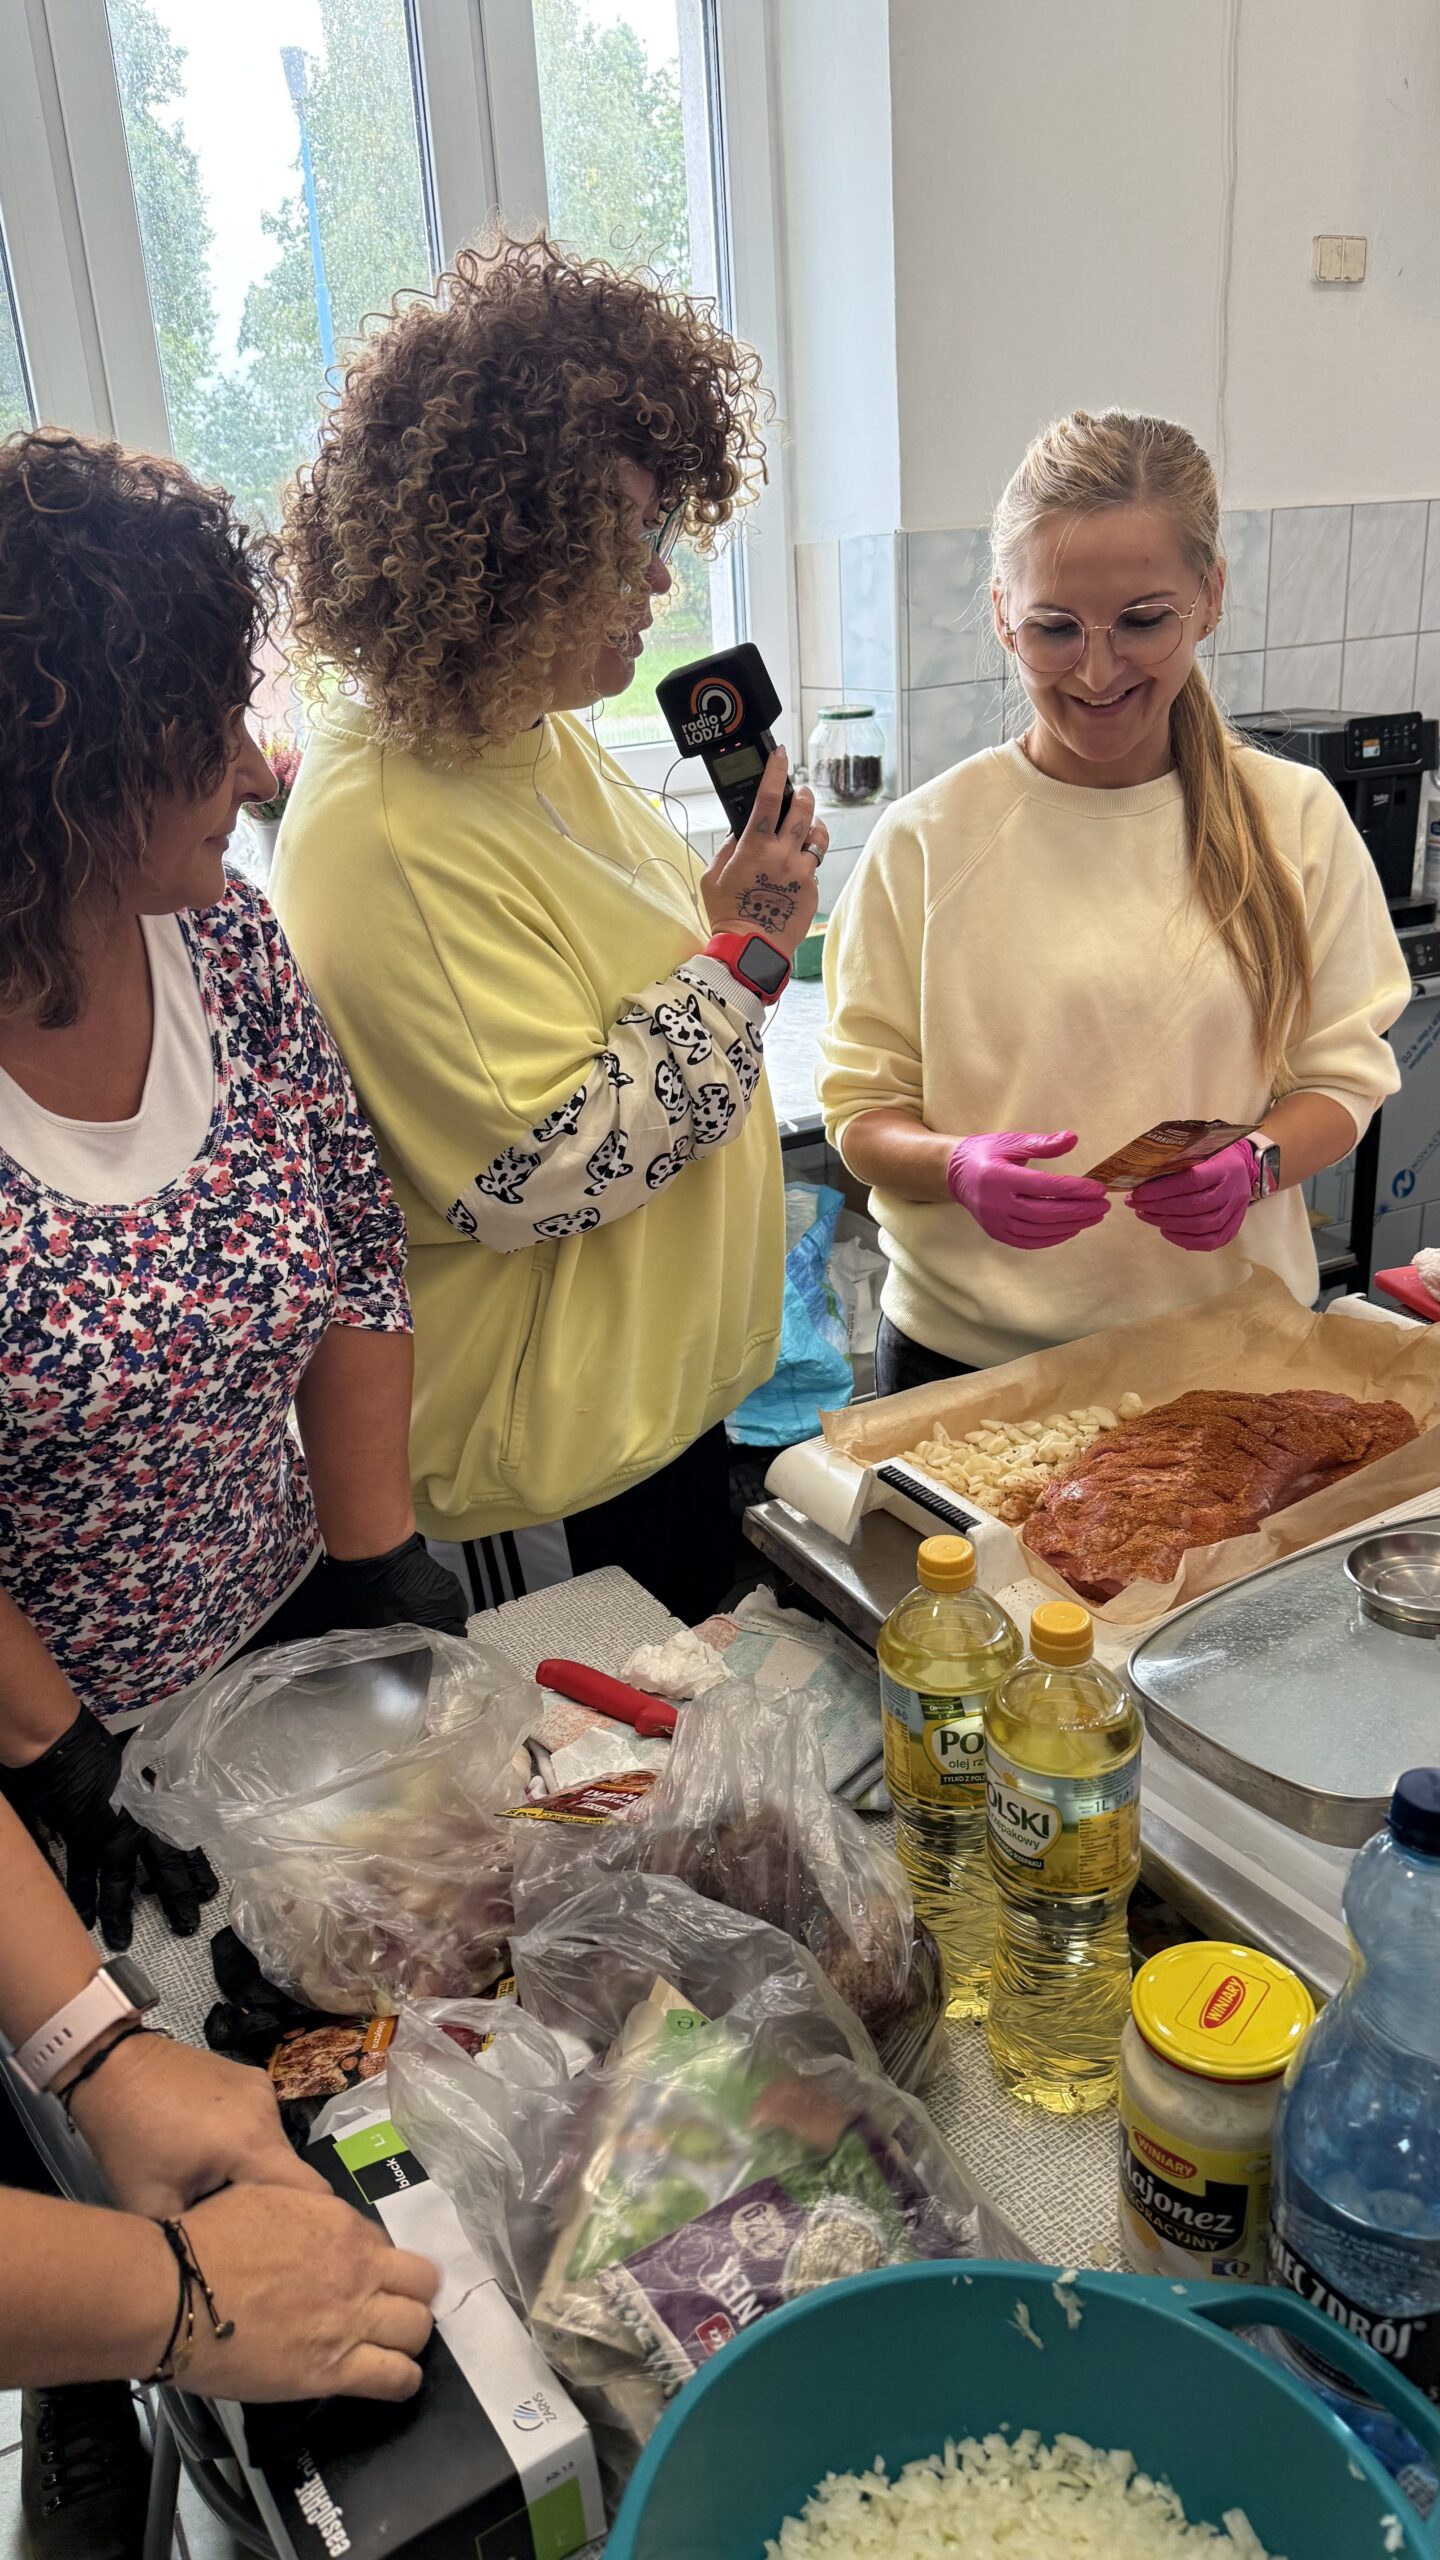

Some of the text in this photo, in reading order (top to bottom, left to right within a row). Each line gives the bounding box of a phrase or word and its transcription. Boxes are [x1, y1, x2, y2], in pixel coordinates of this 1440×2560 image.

[681, 712, 719, 734] radio
[943, 1775, 964, 1783] TYLKO
[948, 1758, 970, 1770] olej
[987, 1780, 1050, 1840] OLSKI
[1205, 1977, 1241, 2022] WINIARY
[386, 2157, 410, 2189] black
[1138, 2134, 1194, 2178] WINIARY
[703, 2253, 764, 2327] NEK
